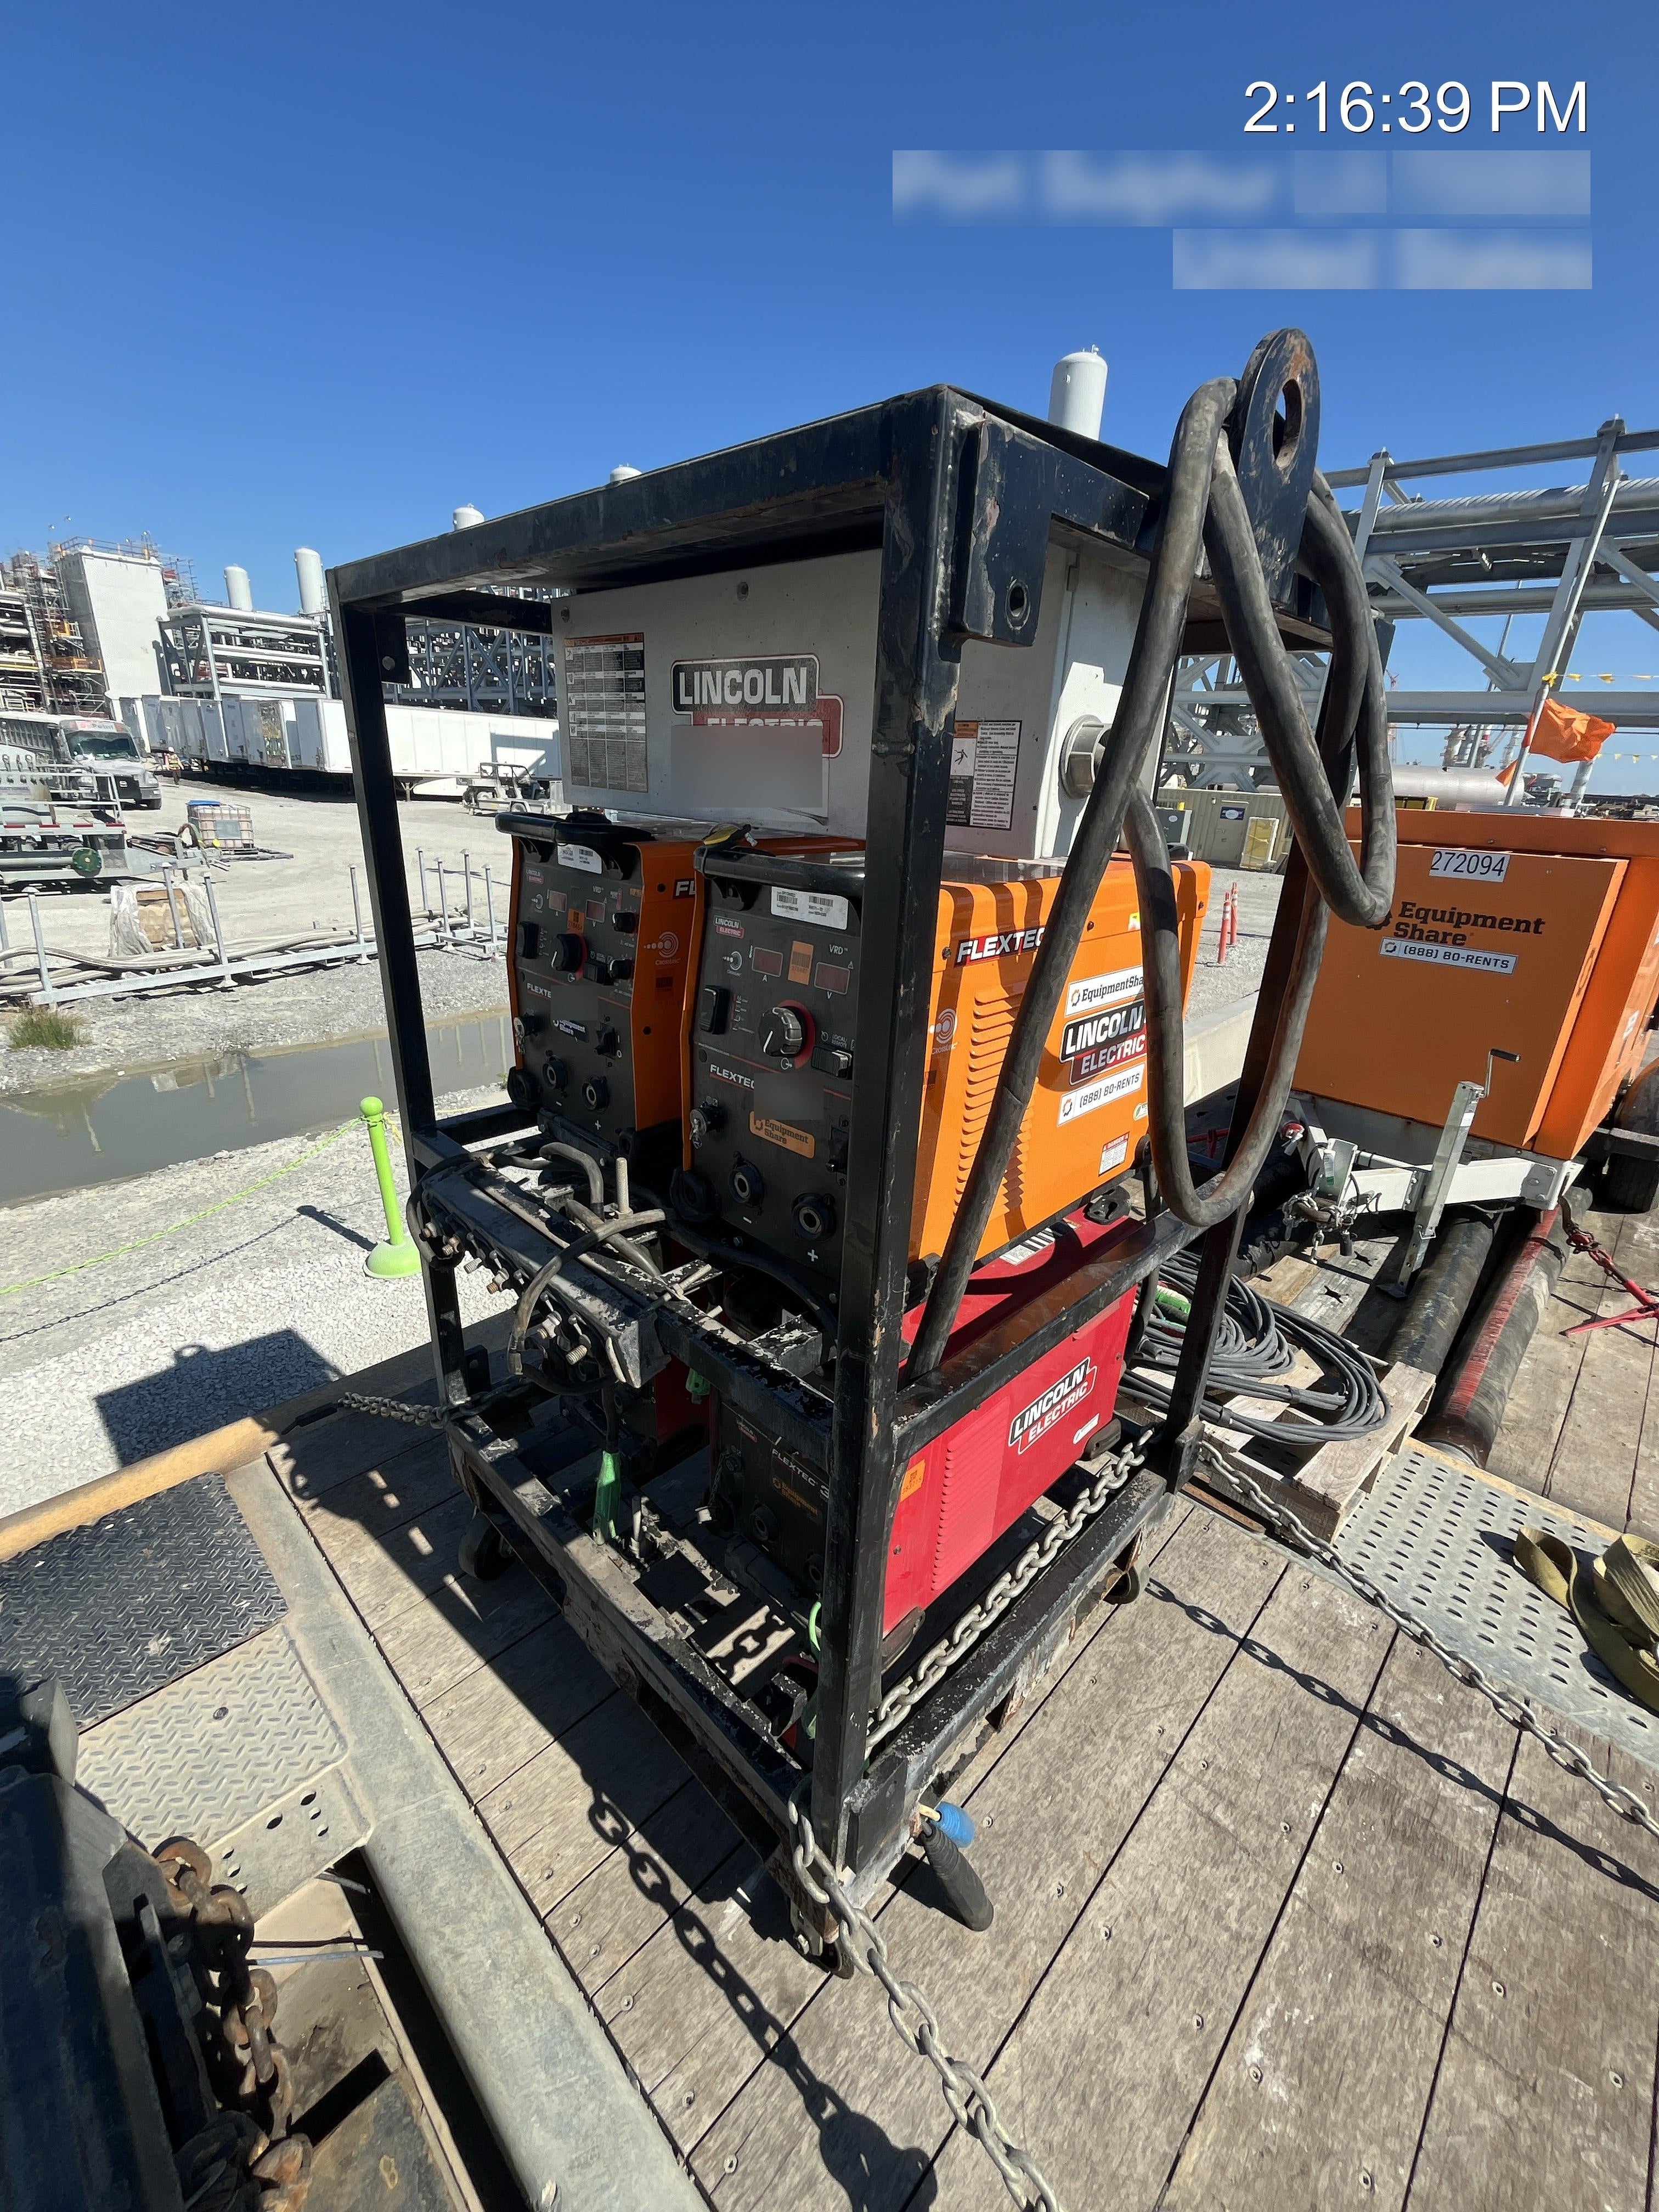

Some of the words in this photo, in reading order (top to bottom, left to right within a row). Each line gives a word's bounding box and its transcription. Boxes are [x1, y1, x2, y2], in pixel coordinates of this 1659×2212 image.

[679, 667, 807, 705] LINCOLN
[1431, 850, 1506, 877] 272094
[715, 917, 740, 929] LINCOLN
[1393, 921, 1467, 946] Share
[1398, 901, 1545, 935] Equipment
[1403, 945, 1438, 958] (888)
[1442, 951, 1510, 969] 80-RENTS
[527, 982, 551, 998] FLEXTE
[1081, 974, 1144, 1003] EquipmentSha
[1065, 1005, 1144, 1056] LINCOLN
[1081, 1034, 1146, 1075] ELECTRIC
[1079, 1090, 1102, 1108] (888)
[1103, 1073, 1140, 1097] 80-RENTS
[765, 1120, 809, 1144] Equipment
[1014, 1364, 1085, 1439] LINCOLN
[1028, 1381, 1088, 1443] ELECTRIC
[772, 1448, 816, 1487] FLEXTEC
